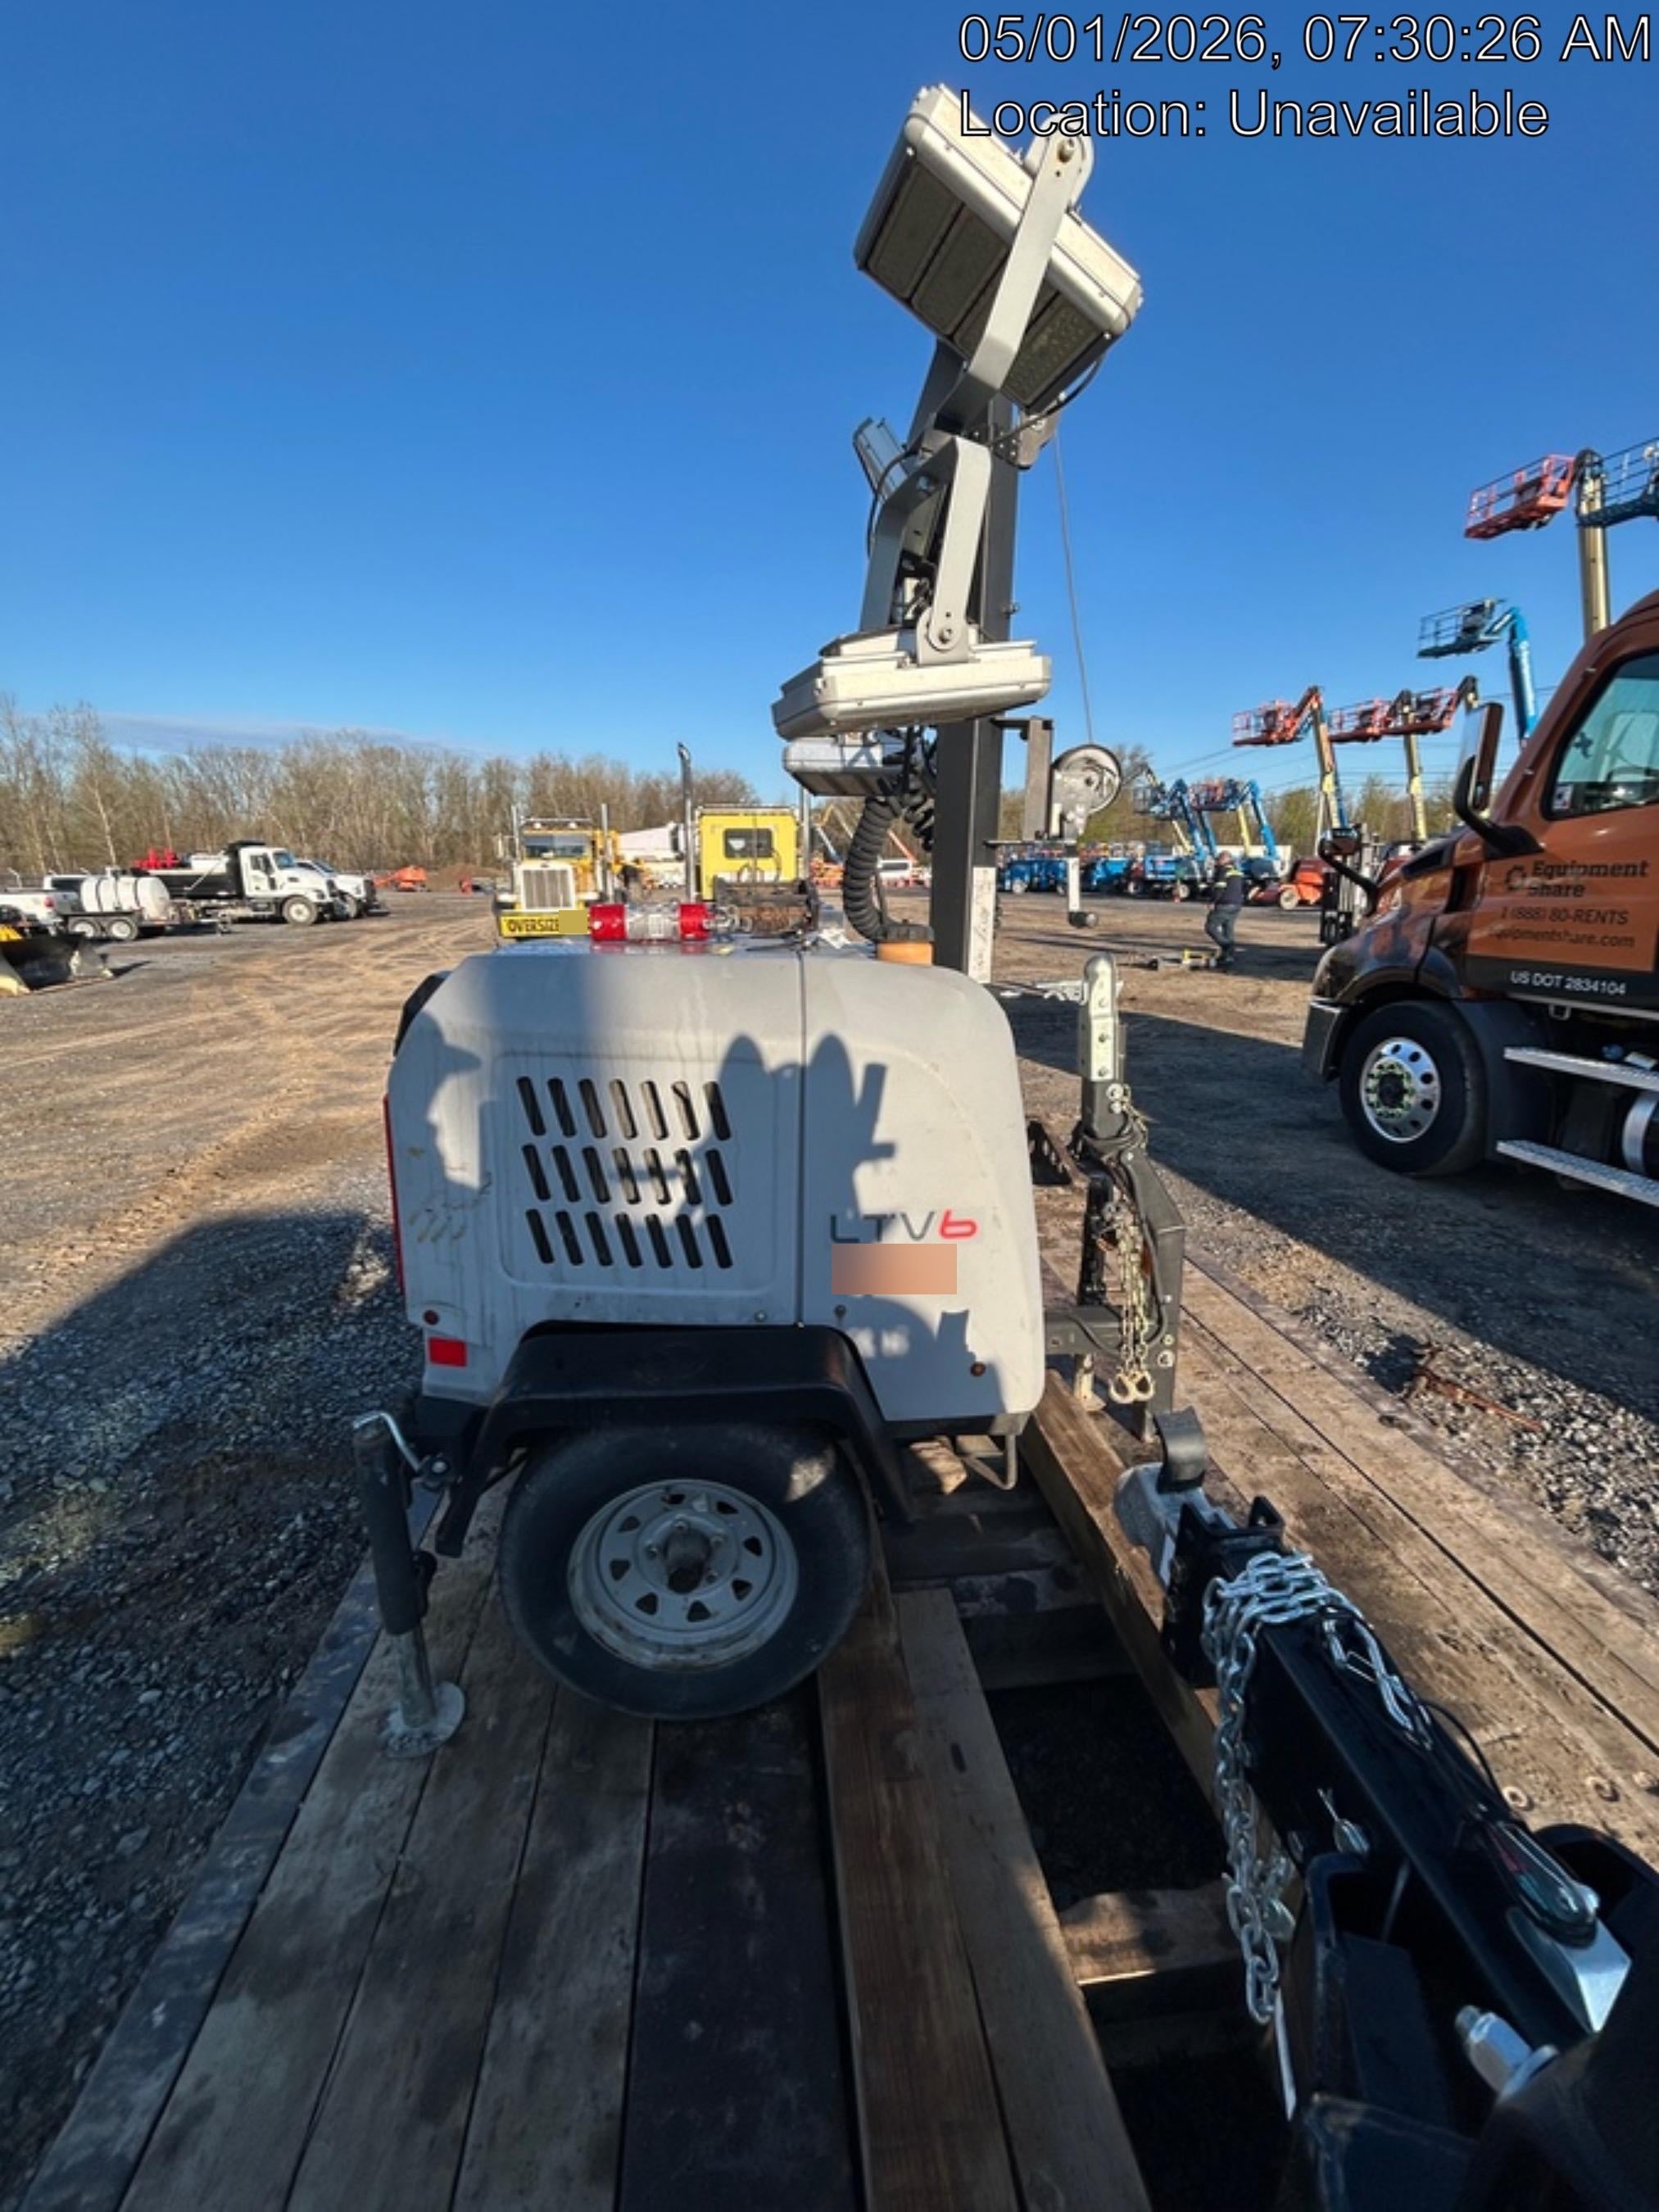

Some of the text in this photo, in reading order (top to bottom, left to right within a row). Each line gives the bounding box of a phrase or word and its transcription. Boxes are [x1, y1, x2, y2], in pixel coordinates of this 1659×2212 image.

[1530, 860, 1650, 880] Equipment
[1548, 906, 1630, 925] 80-RENTS
[1510, 970, 1627, 996] US DOT 2834104
